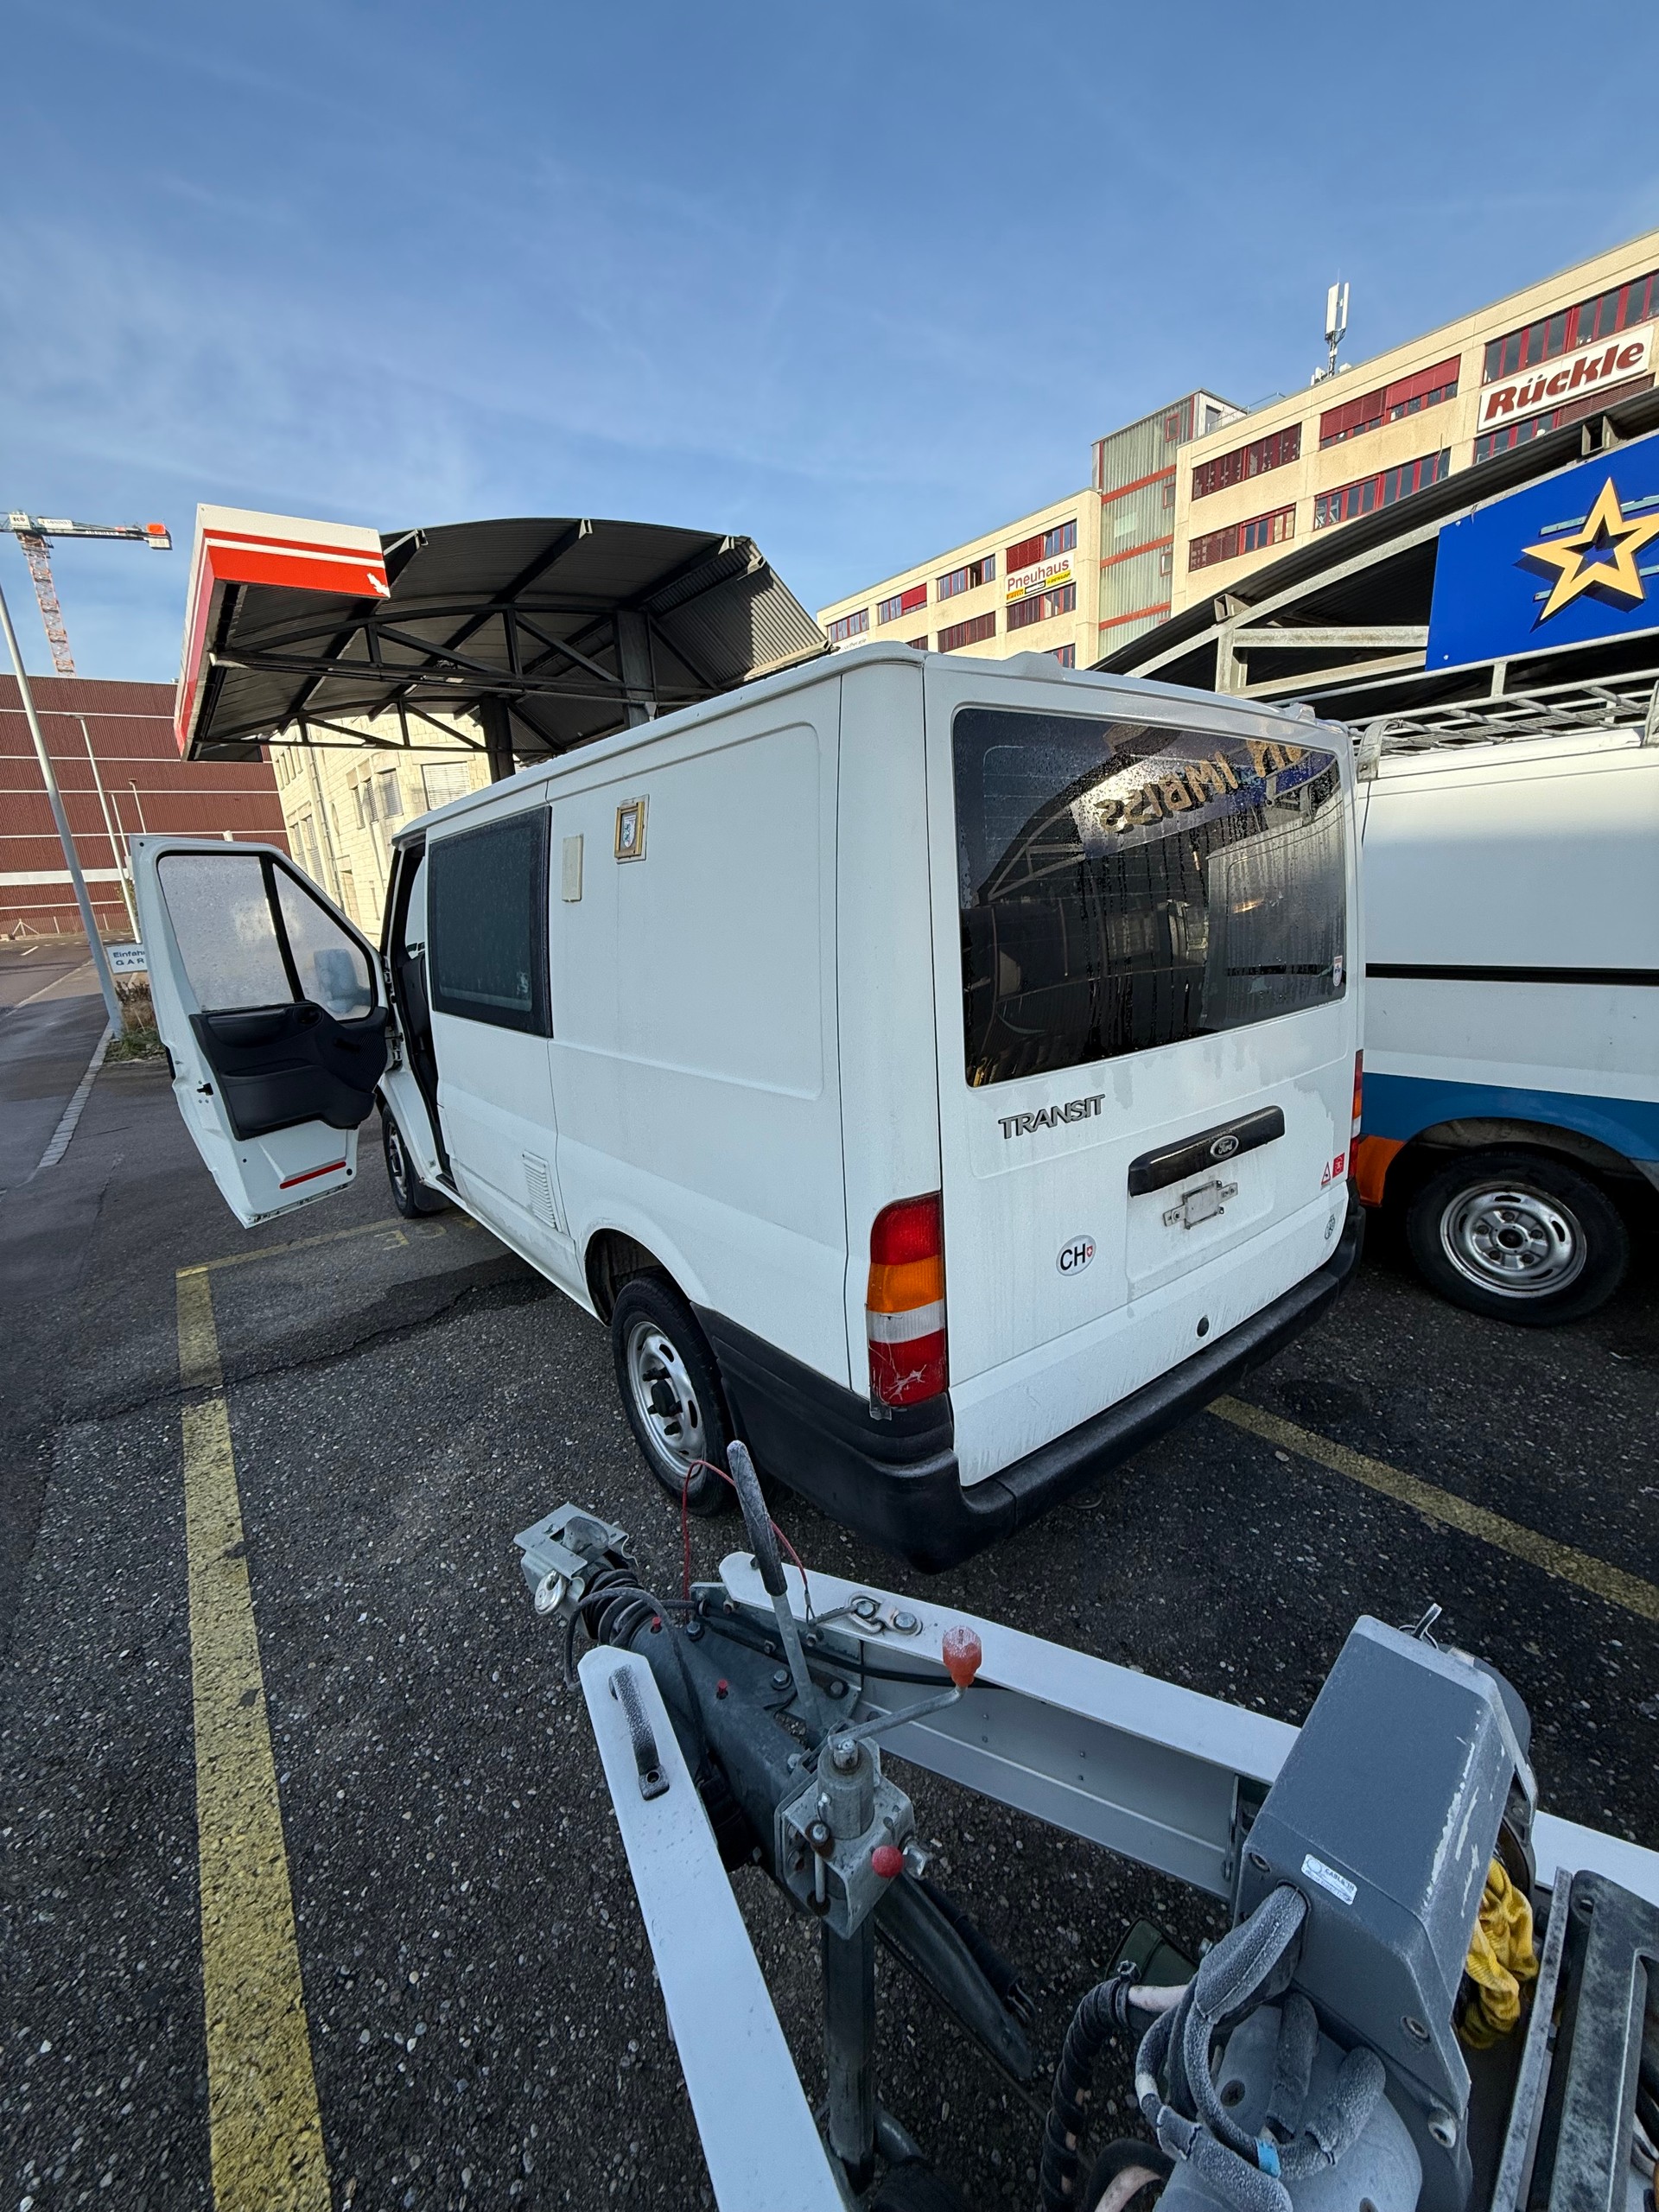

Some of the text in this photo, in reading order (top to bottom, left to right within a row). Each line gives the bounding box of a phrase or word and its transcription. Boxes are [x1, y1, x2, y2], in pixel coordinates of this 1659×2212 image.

[1484, 342, 1645, 422] Rückle
[1007, 559, 1069, 592] Pneuhaus
[998, 1094, 1105, 1139] TRANSIT
[1059, 1243, 1086, 1270] CH
